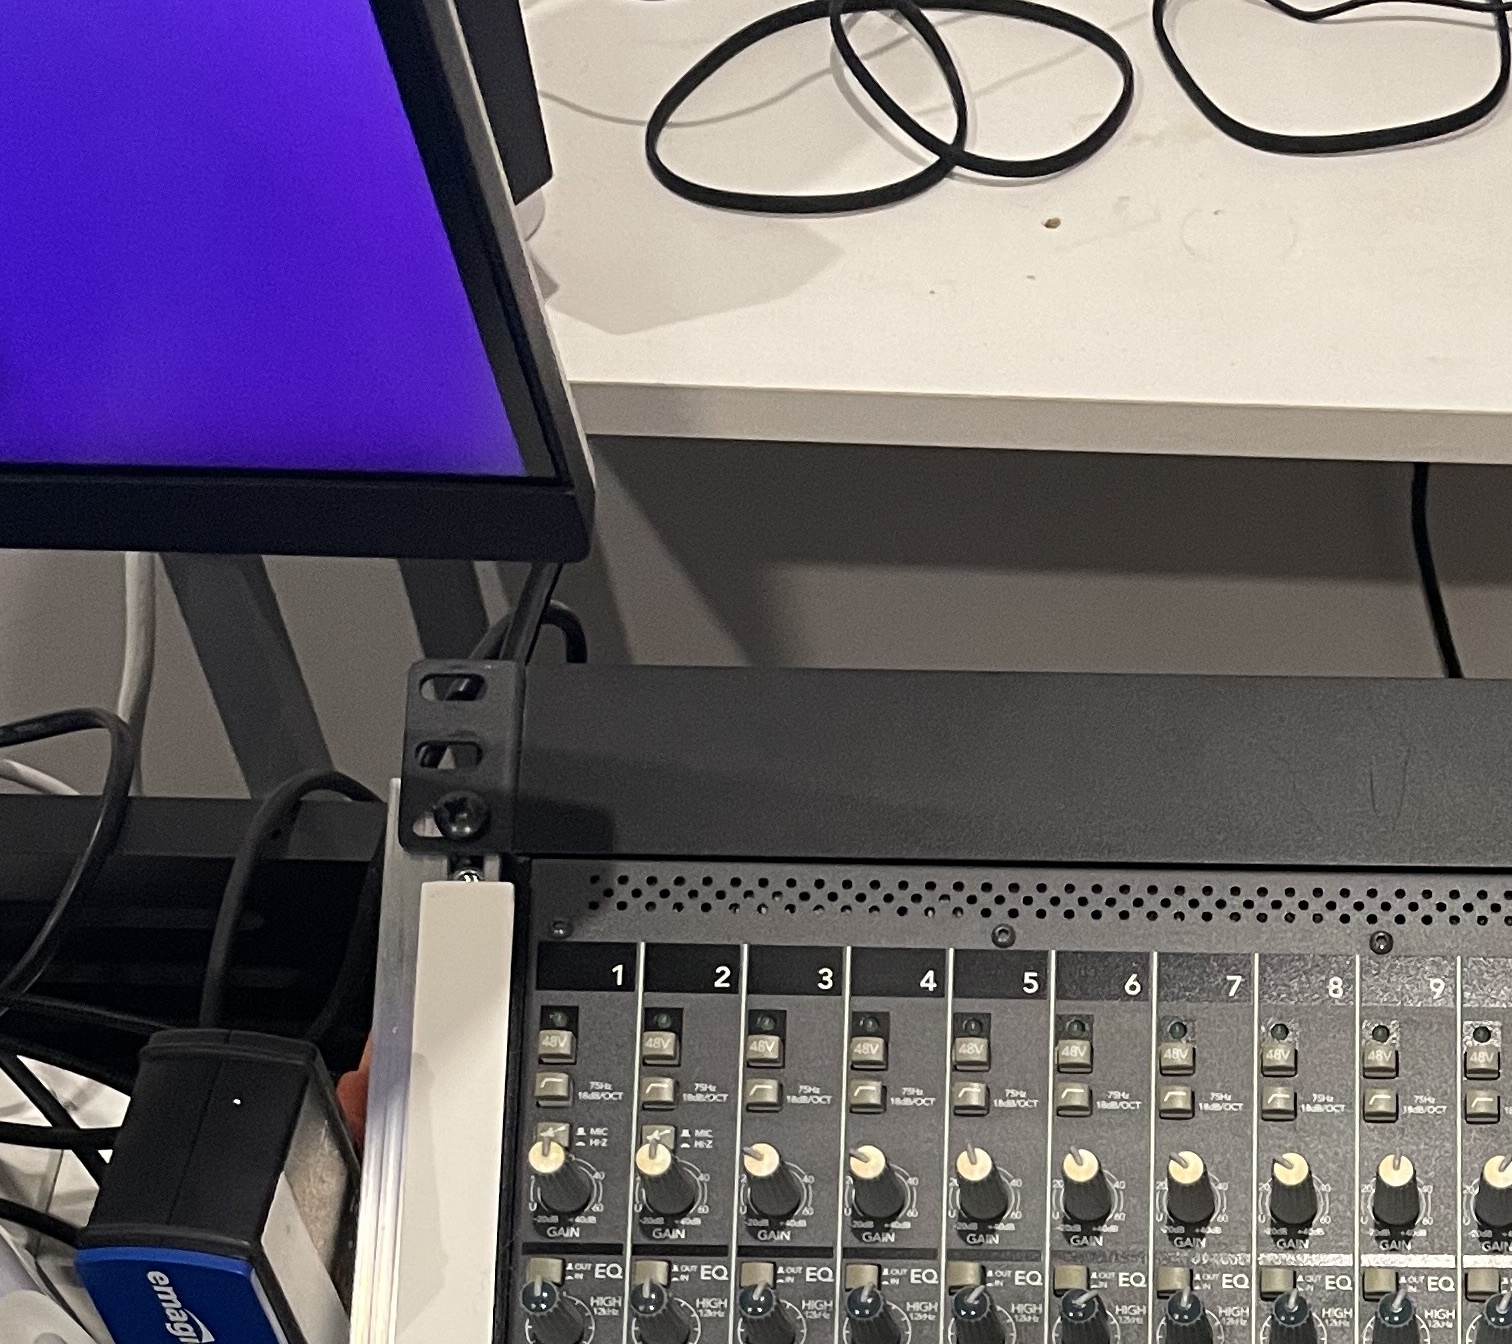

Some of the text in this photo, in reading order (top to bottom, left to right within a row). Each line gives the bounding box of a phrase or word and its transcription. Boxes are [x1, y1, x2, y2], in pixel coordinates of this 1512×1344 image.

[612, 965, 622, 985] 1
[920, 970, 937, 991] 4
[1227, 976, 1245, 998] 7
[542, 1034, 570, 1051] 48V
[758, 1226, 793, 1242] GAIN
[806, 1267, 837, 1284] EQ
